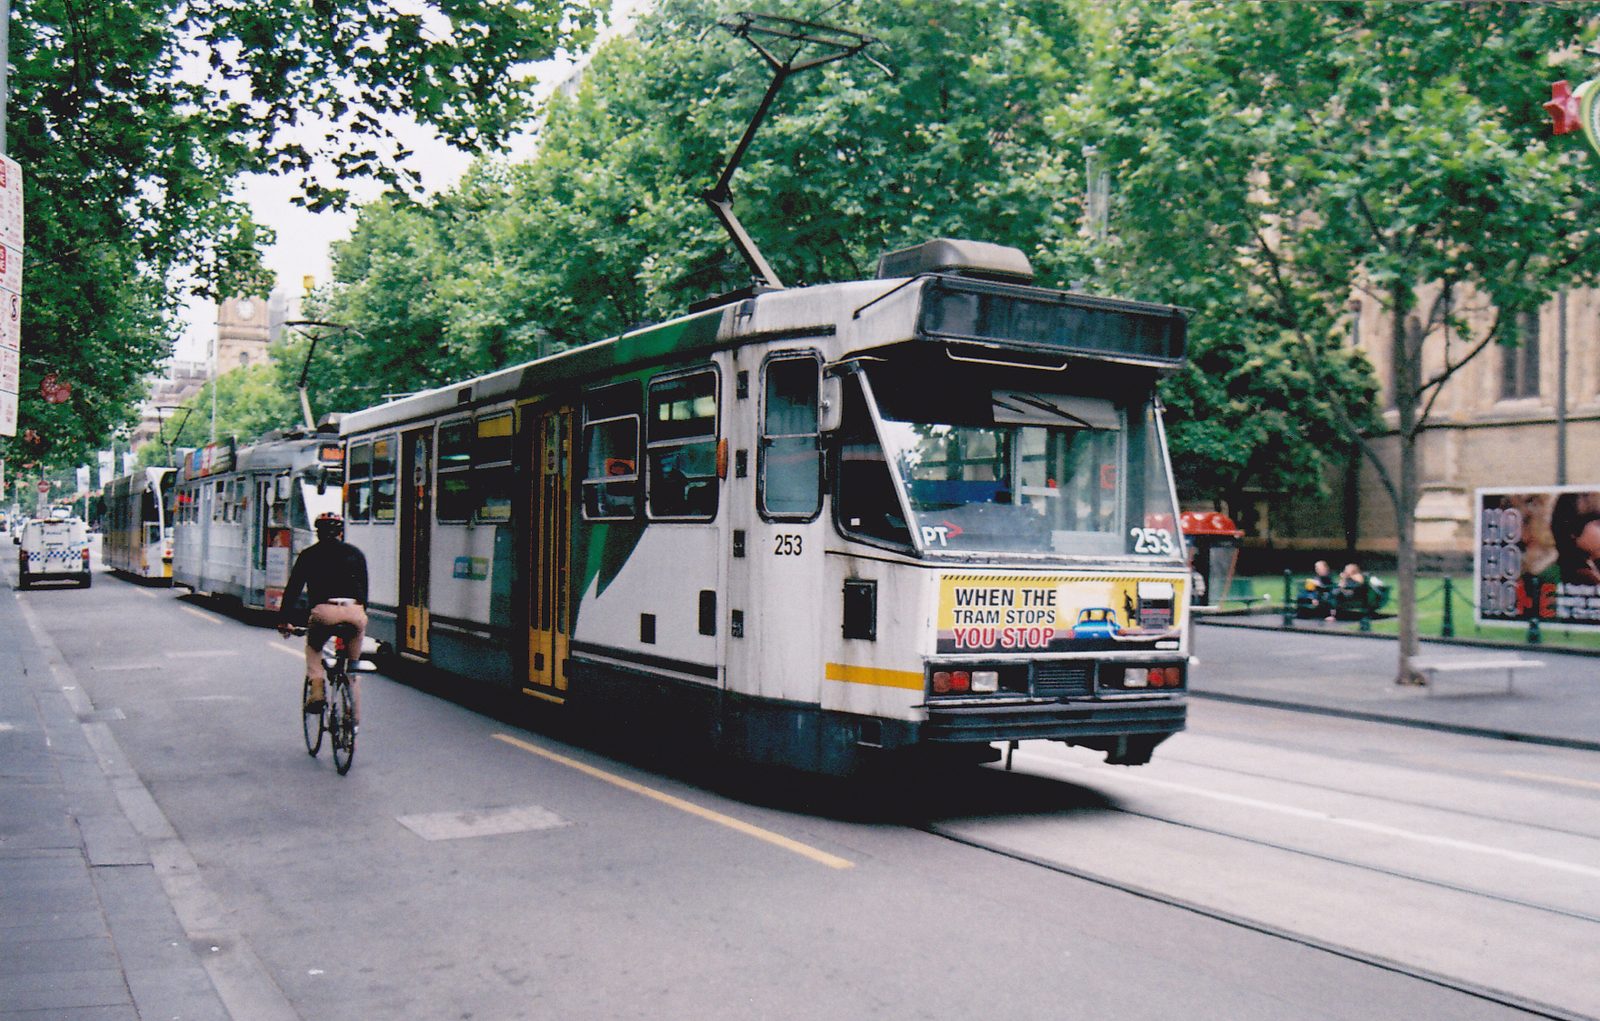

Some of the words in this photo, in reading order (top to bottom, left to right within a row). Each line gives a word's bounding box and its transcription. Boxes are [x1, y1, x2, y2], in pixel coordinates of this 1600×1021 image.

[921, 526, 948, 547] PT
[1482, 508, 1521, 544] HO
[774, 534, 803, 556] 253
[1130, 527, 1173, 554] 253
[1481, 544, 1520, 580] HO
[955, 588, 1014, 606] WHEN
[1021, 589, 1057, 606] THE
[953, 609, 1000, 624] TRAM
[1005, 609, 1056, 624] STOPS
[953, 627, 996, 647] YOU
[1001, 627, 1054, 646] STOP
